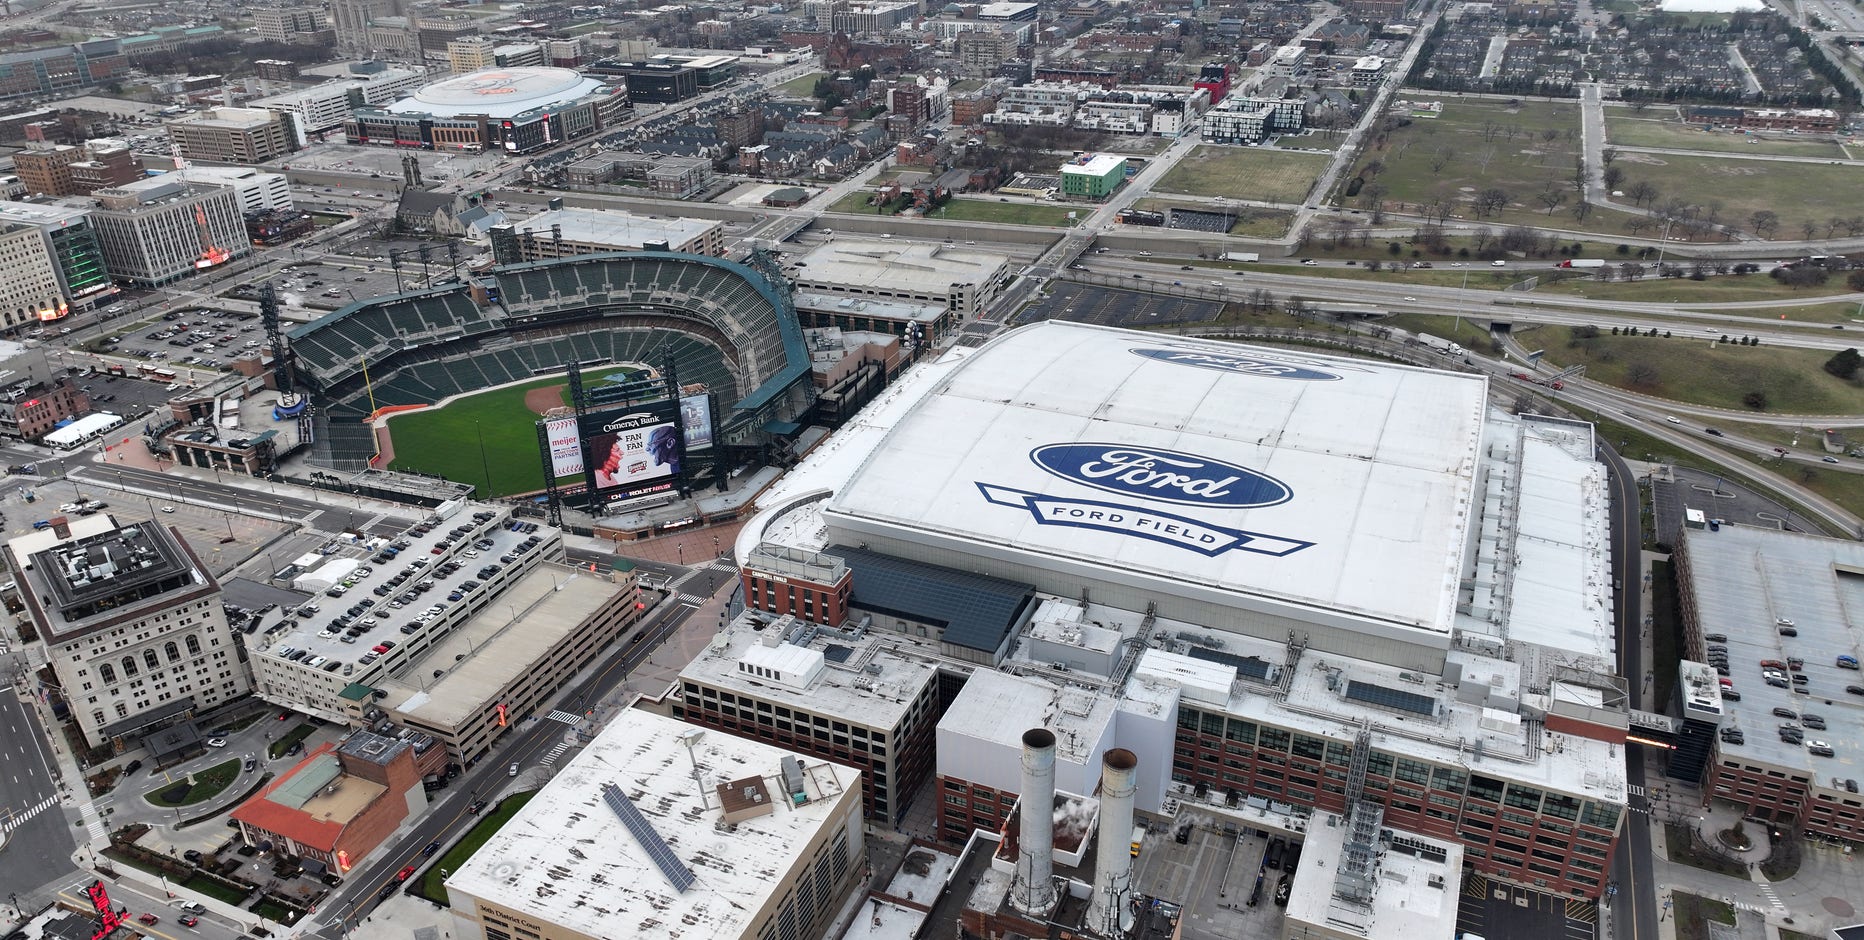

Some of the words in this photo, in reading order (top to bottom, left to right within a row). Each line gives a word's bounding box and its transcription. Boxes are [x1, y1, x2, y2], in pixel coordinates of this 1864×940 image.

[1166, 353, 1297, 376] Ford
[640, 415, 660, 425] Bank
[552, 436, 577, 446] meijer
[625, 433, 642, 442] FAN
[626, 442, 643, 451] FAN
[554, 451, 579, 460] PARTNER
[1080, 450, 1241, 498] Ford
[1052, 506, 1124, 523] FORD
[1136, 518, 1217, 545] FIELD
[480, 905, 495, 914] 36th
[495, 910, 521, 924] District
[520, 919, 542, 932] Court
